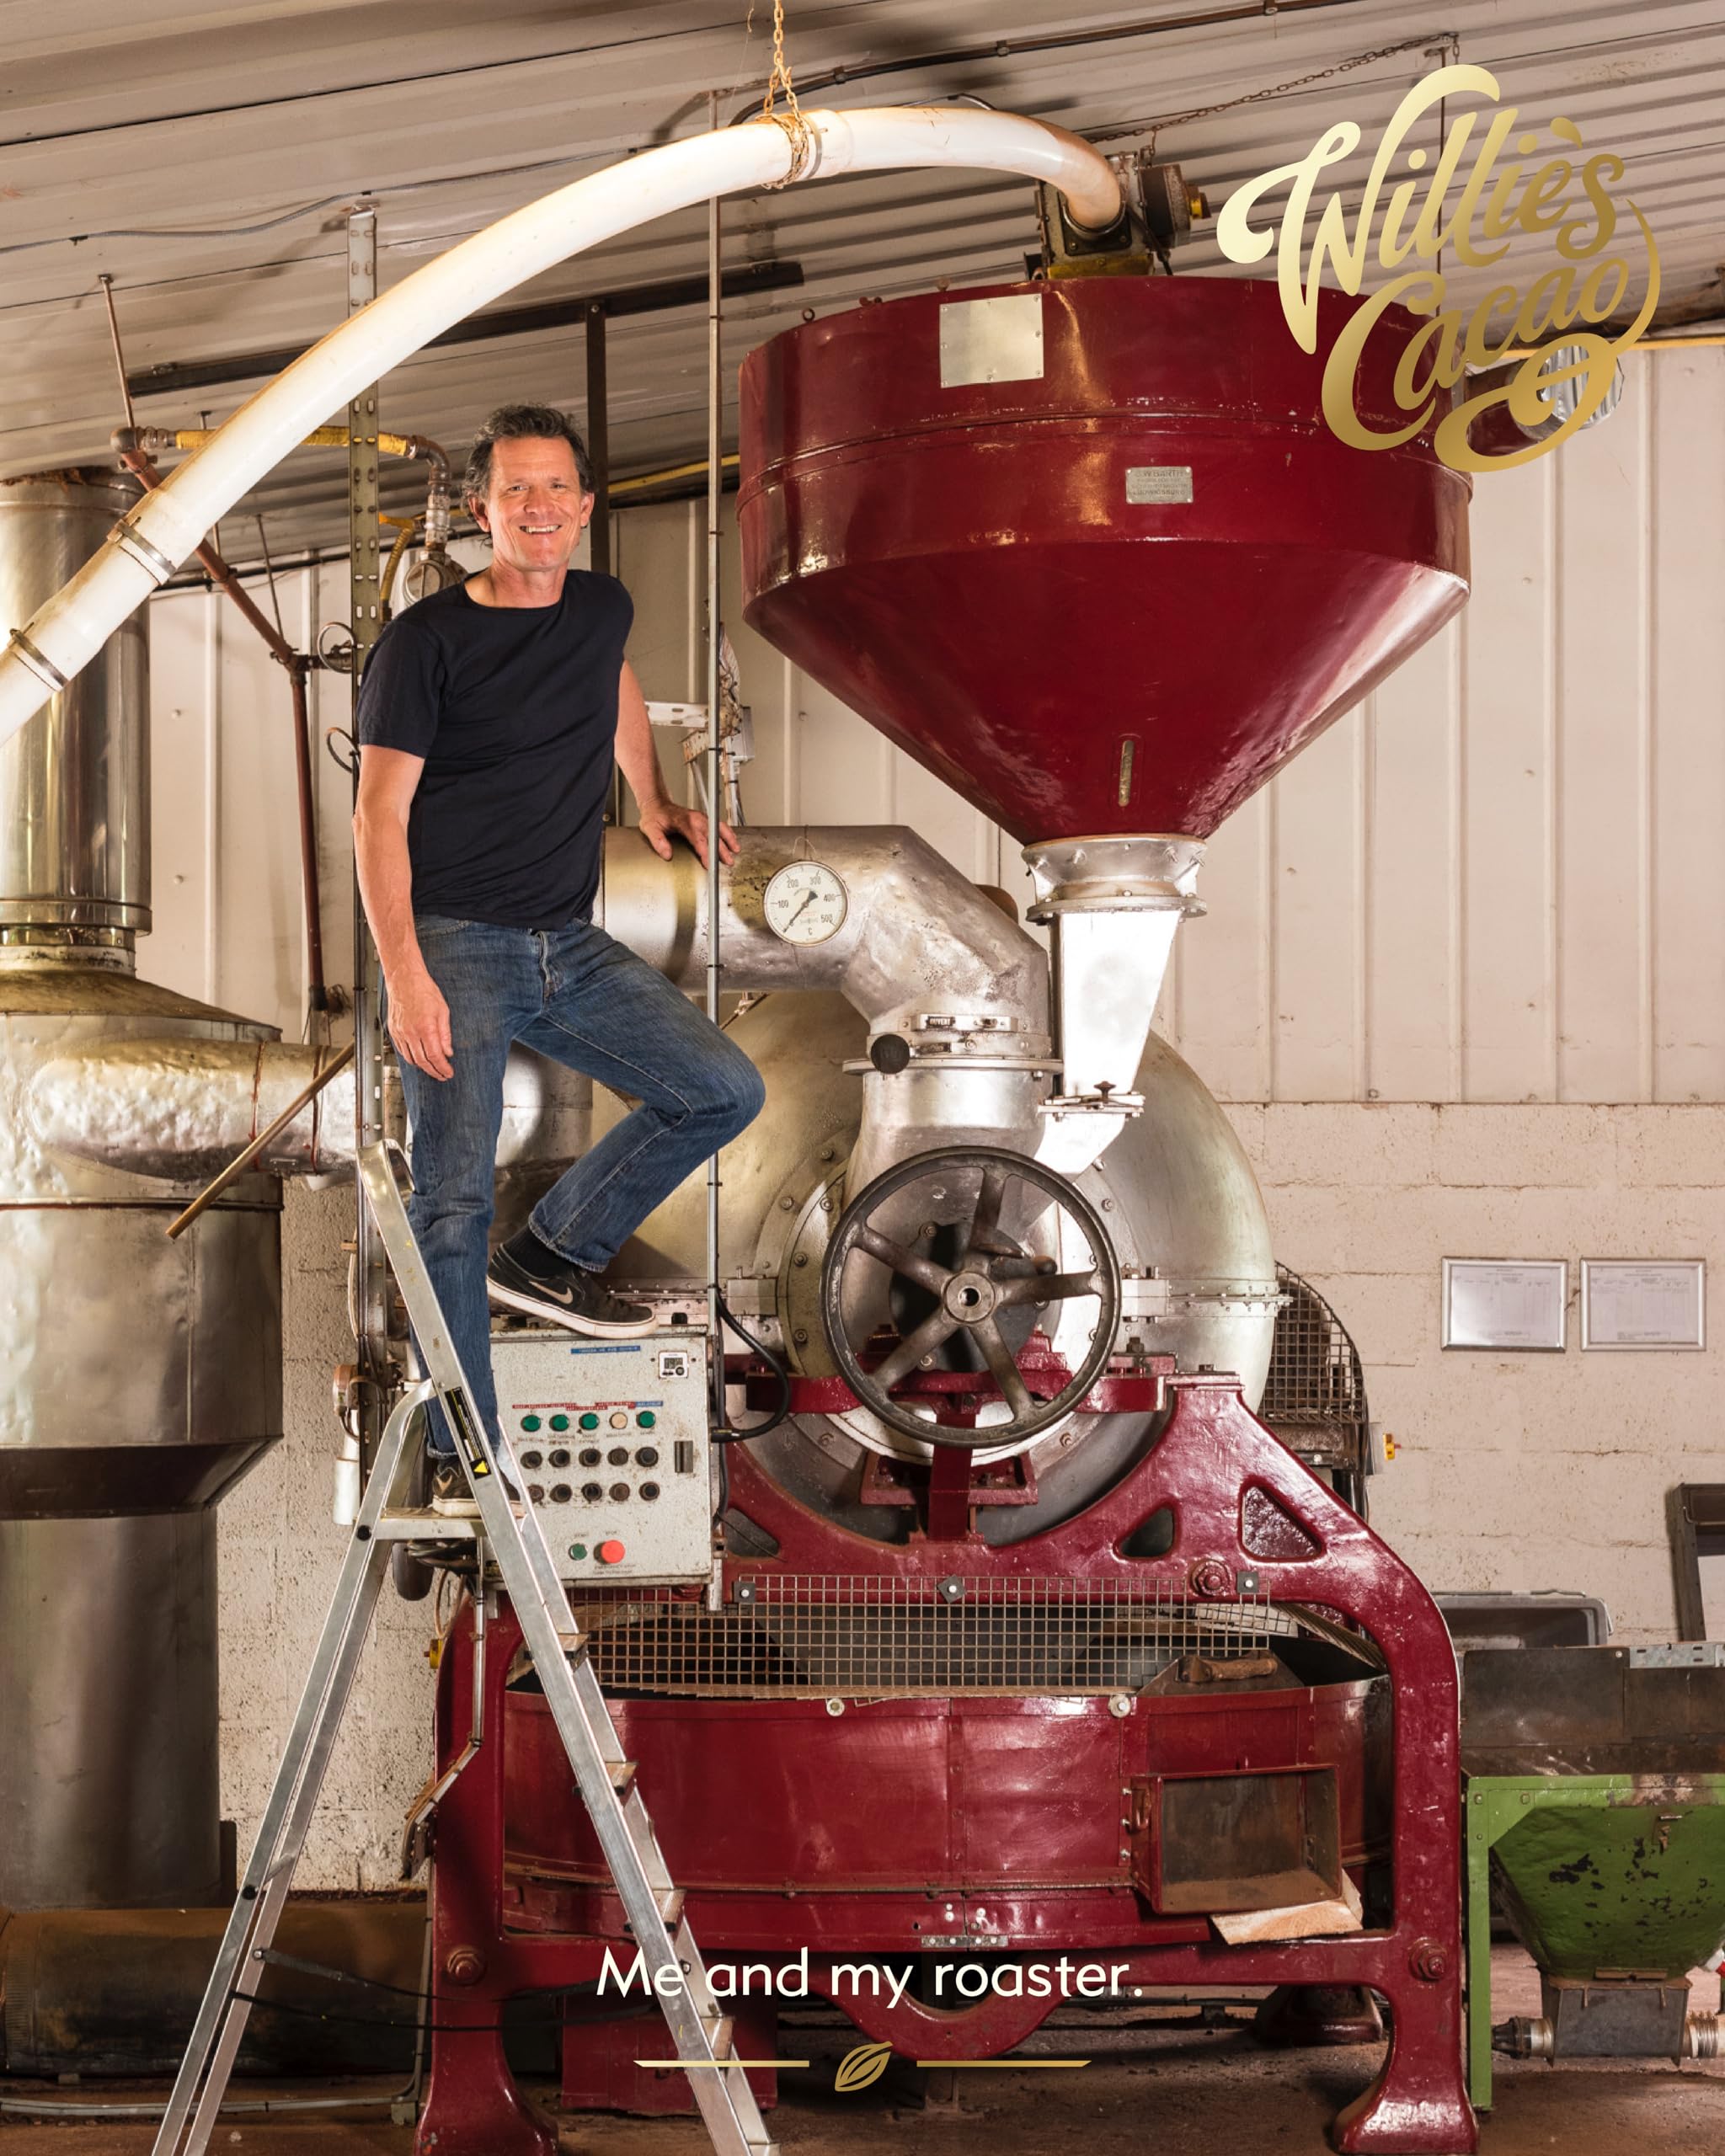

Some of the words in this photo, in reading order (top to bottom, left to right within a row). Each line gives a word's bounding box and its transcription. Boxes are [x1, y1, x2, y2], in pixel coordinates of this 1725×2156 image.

[787, 878, 799, 889] 200
[809, 876, 821, 885] 300
[777, 899, 789, 909] 100
[820, 914, 833, 922] 500
